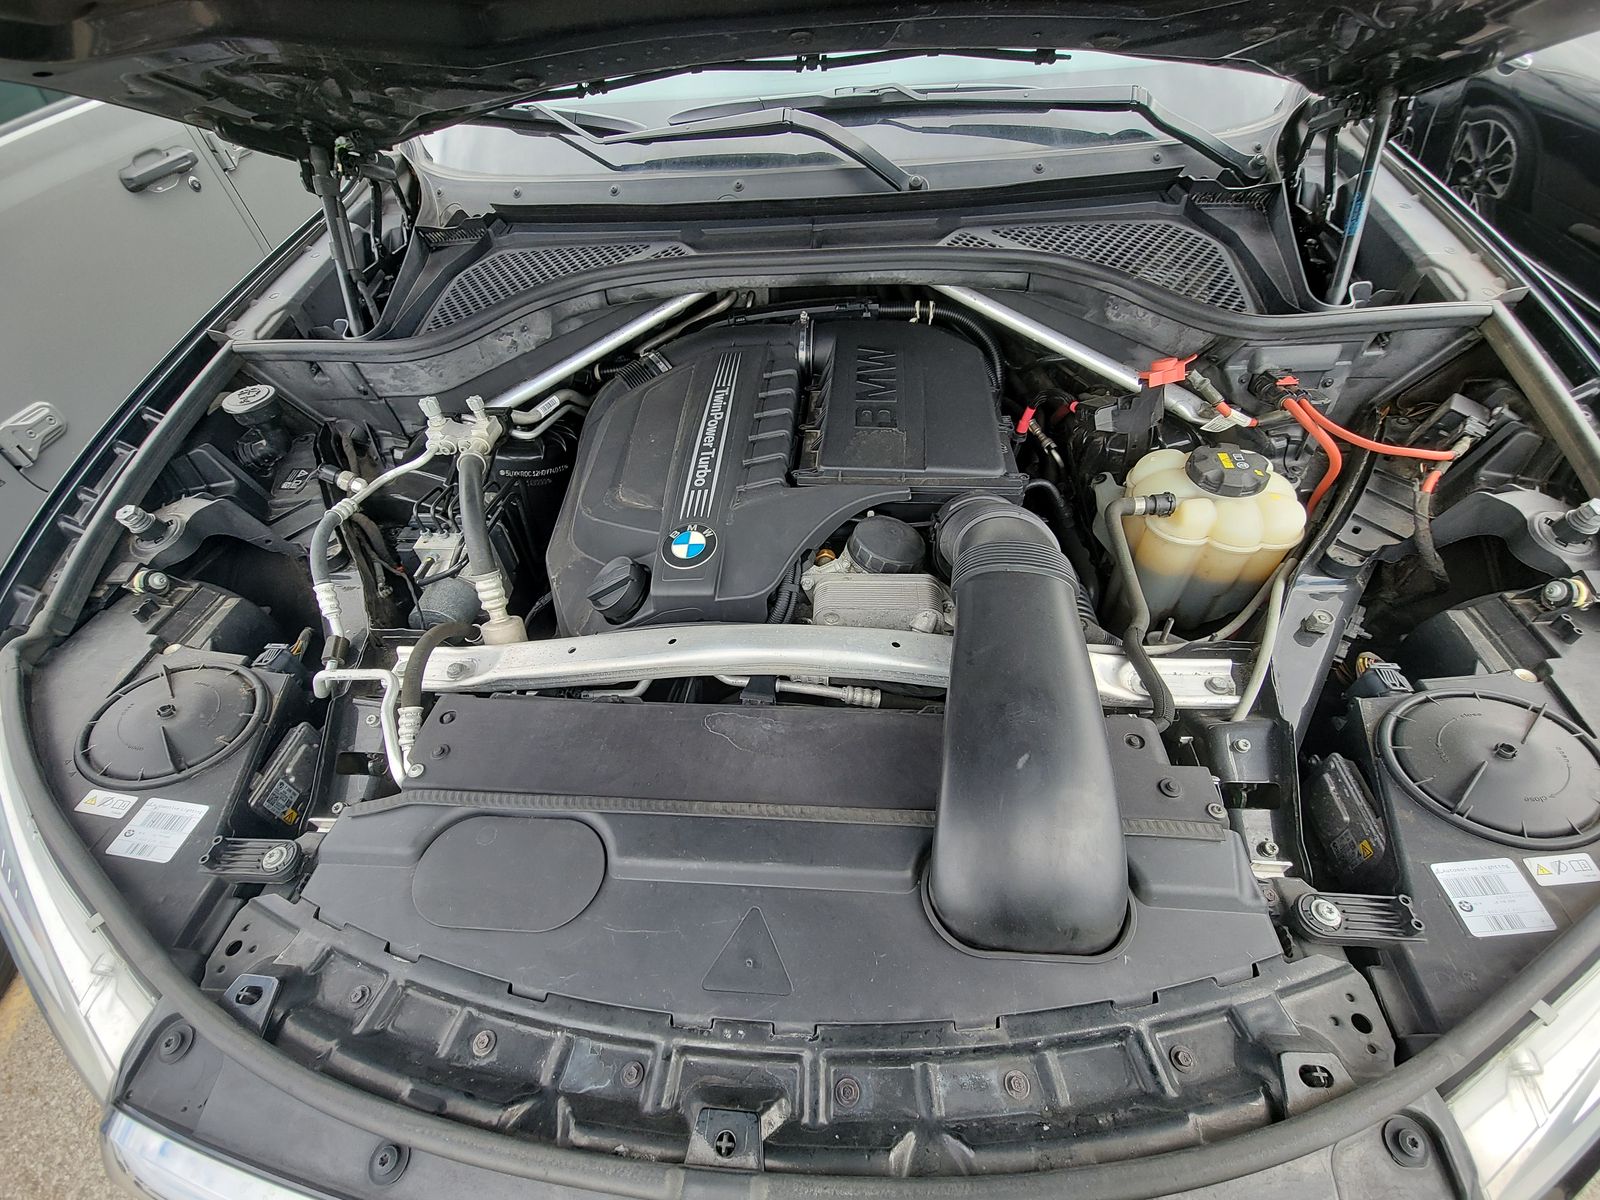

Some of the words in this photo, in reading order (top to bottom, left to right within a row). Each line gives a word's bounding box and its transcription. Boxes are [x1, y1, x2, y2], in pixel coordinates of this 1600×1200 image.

[855, 345, 898, 430] BMW
[702, 386, 729, 448] TwinPower
[693, 448, 716, 487] Turbo
[669, 524, 714, 539] BMW
